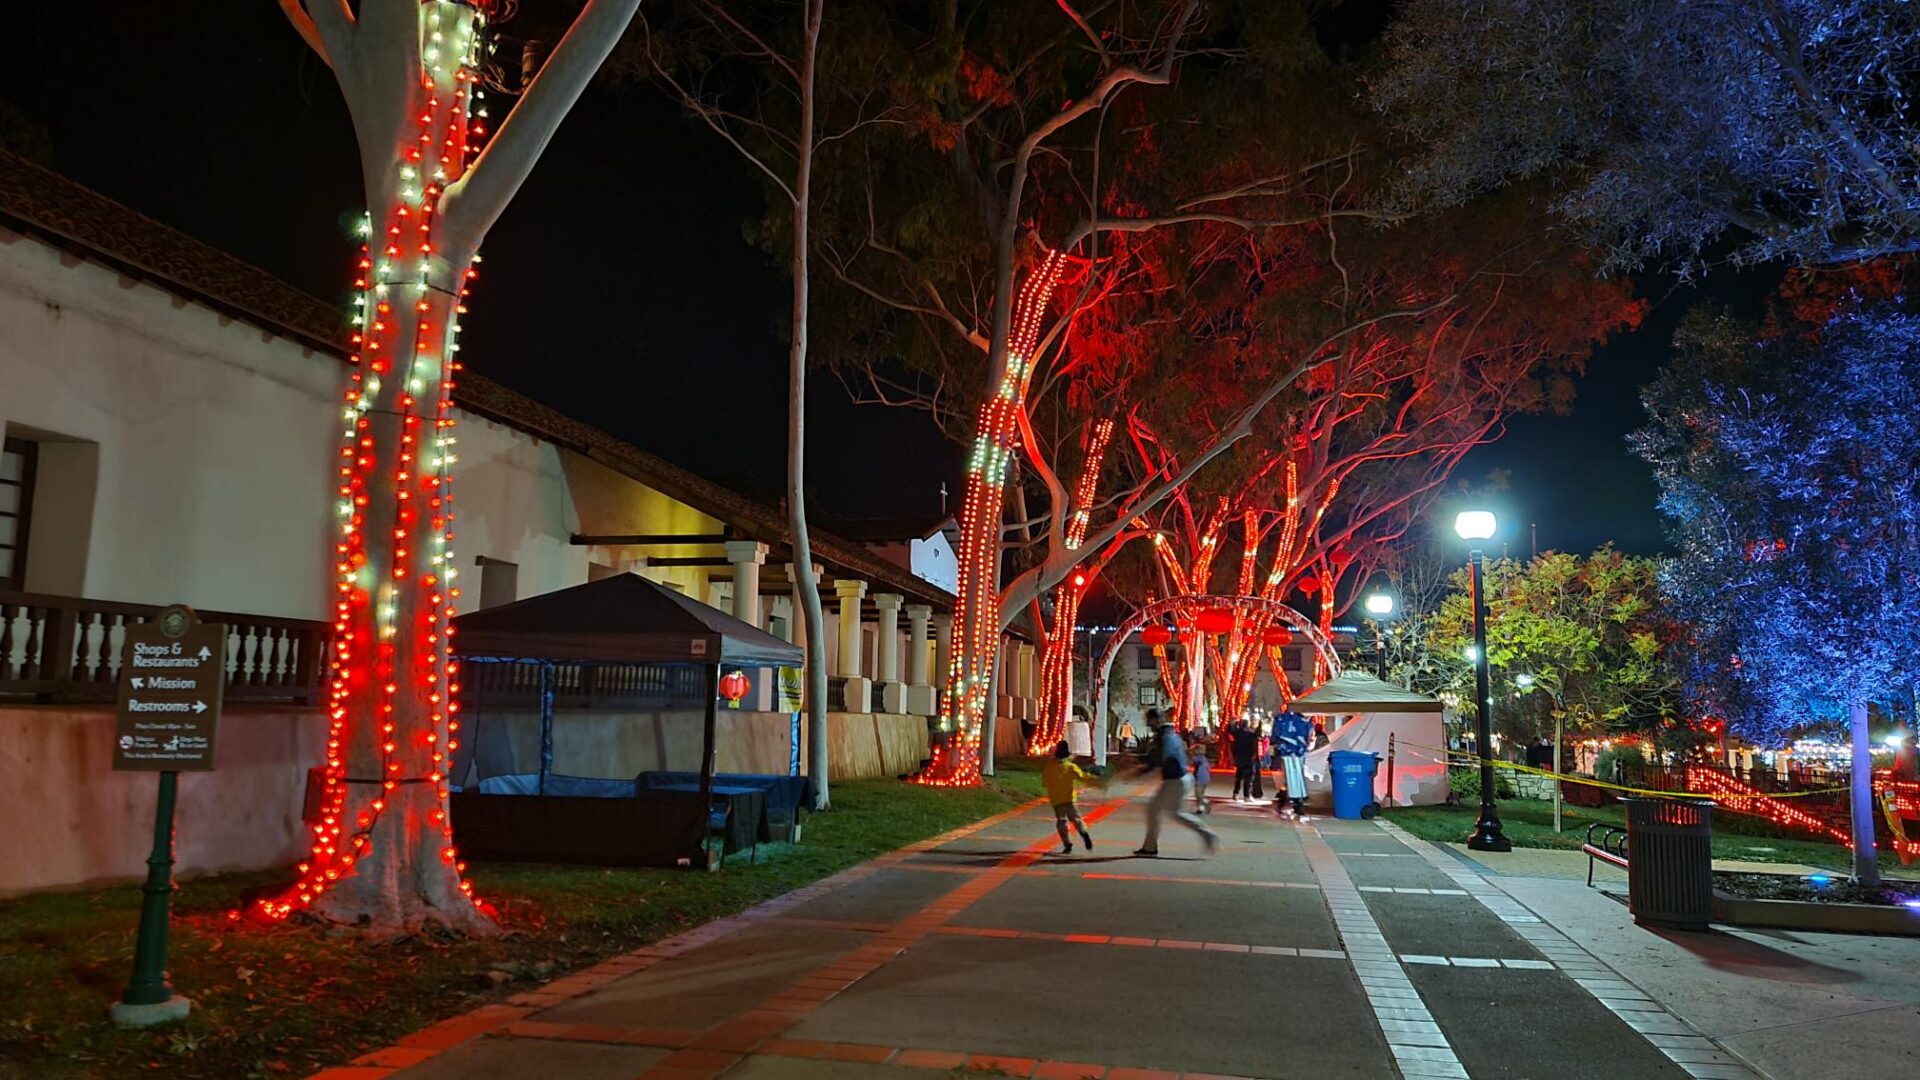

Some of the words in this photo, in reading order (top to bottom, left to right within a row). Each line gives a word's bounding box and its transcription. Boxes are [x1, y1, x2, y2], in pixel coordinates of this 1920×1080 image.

[134, 642, 169, 657] Shops
[171, 642, 183, 655] &
[132, 655, 200, 668] Restaurants
[147, 676, 196, 689] Mission
[128, 699, 190, 712] Restrooms
